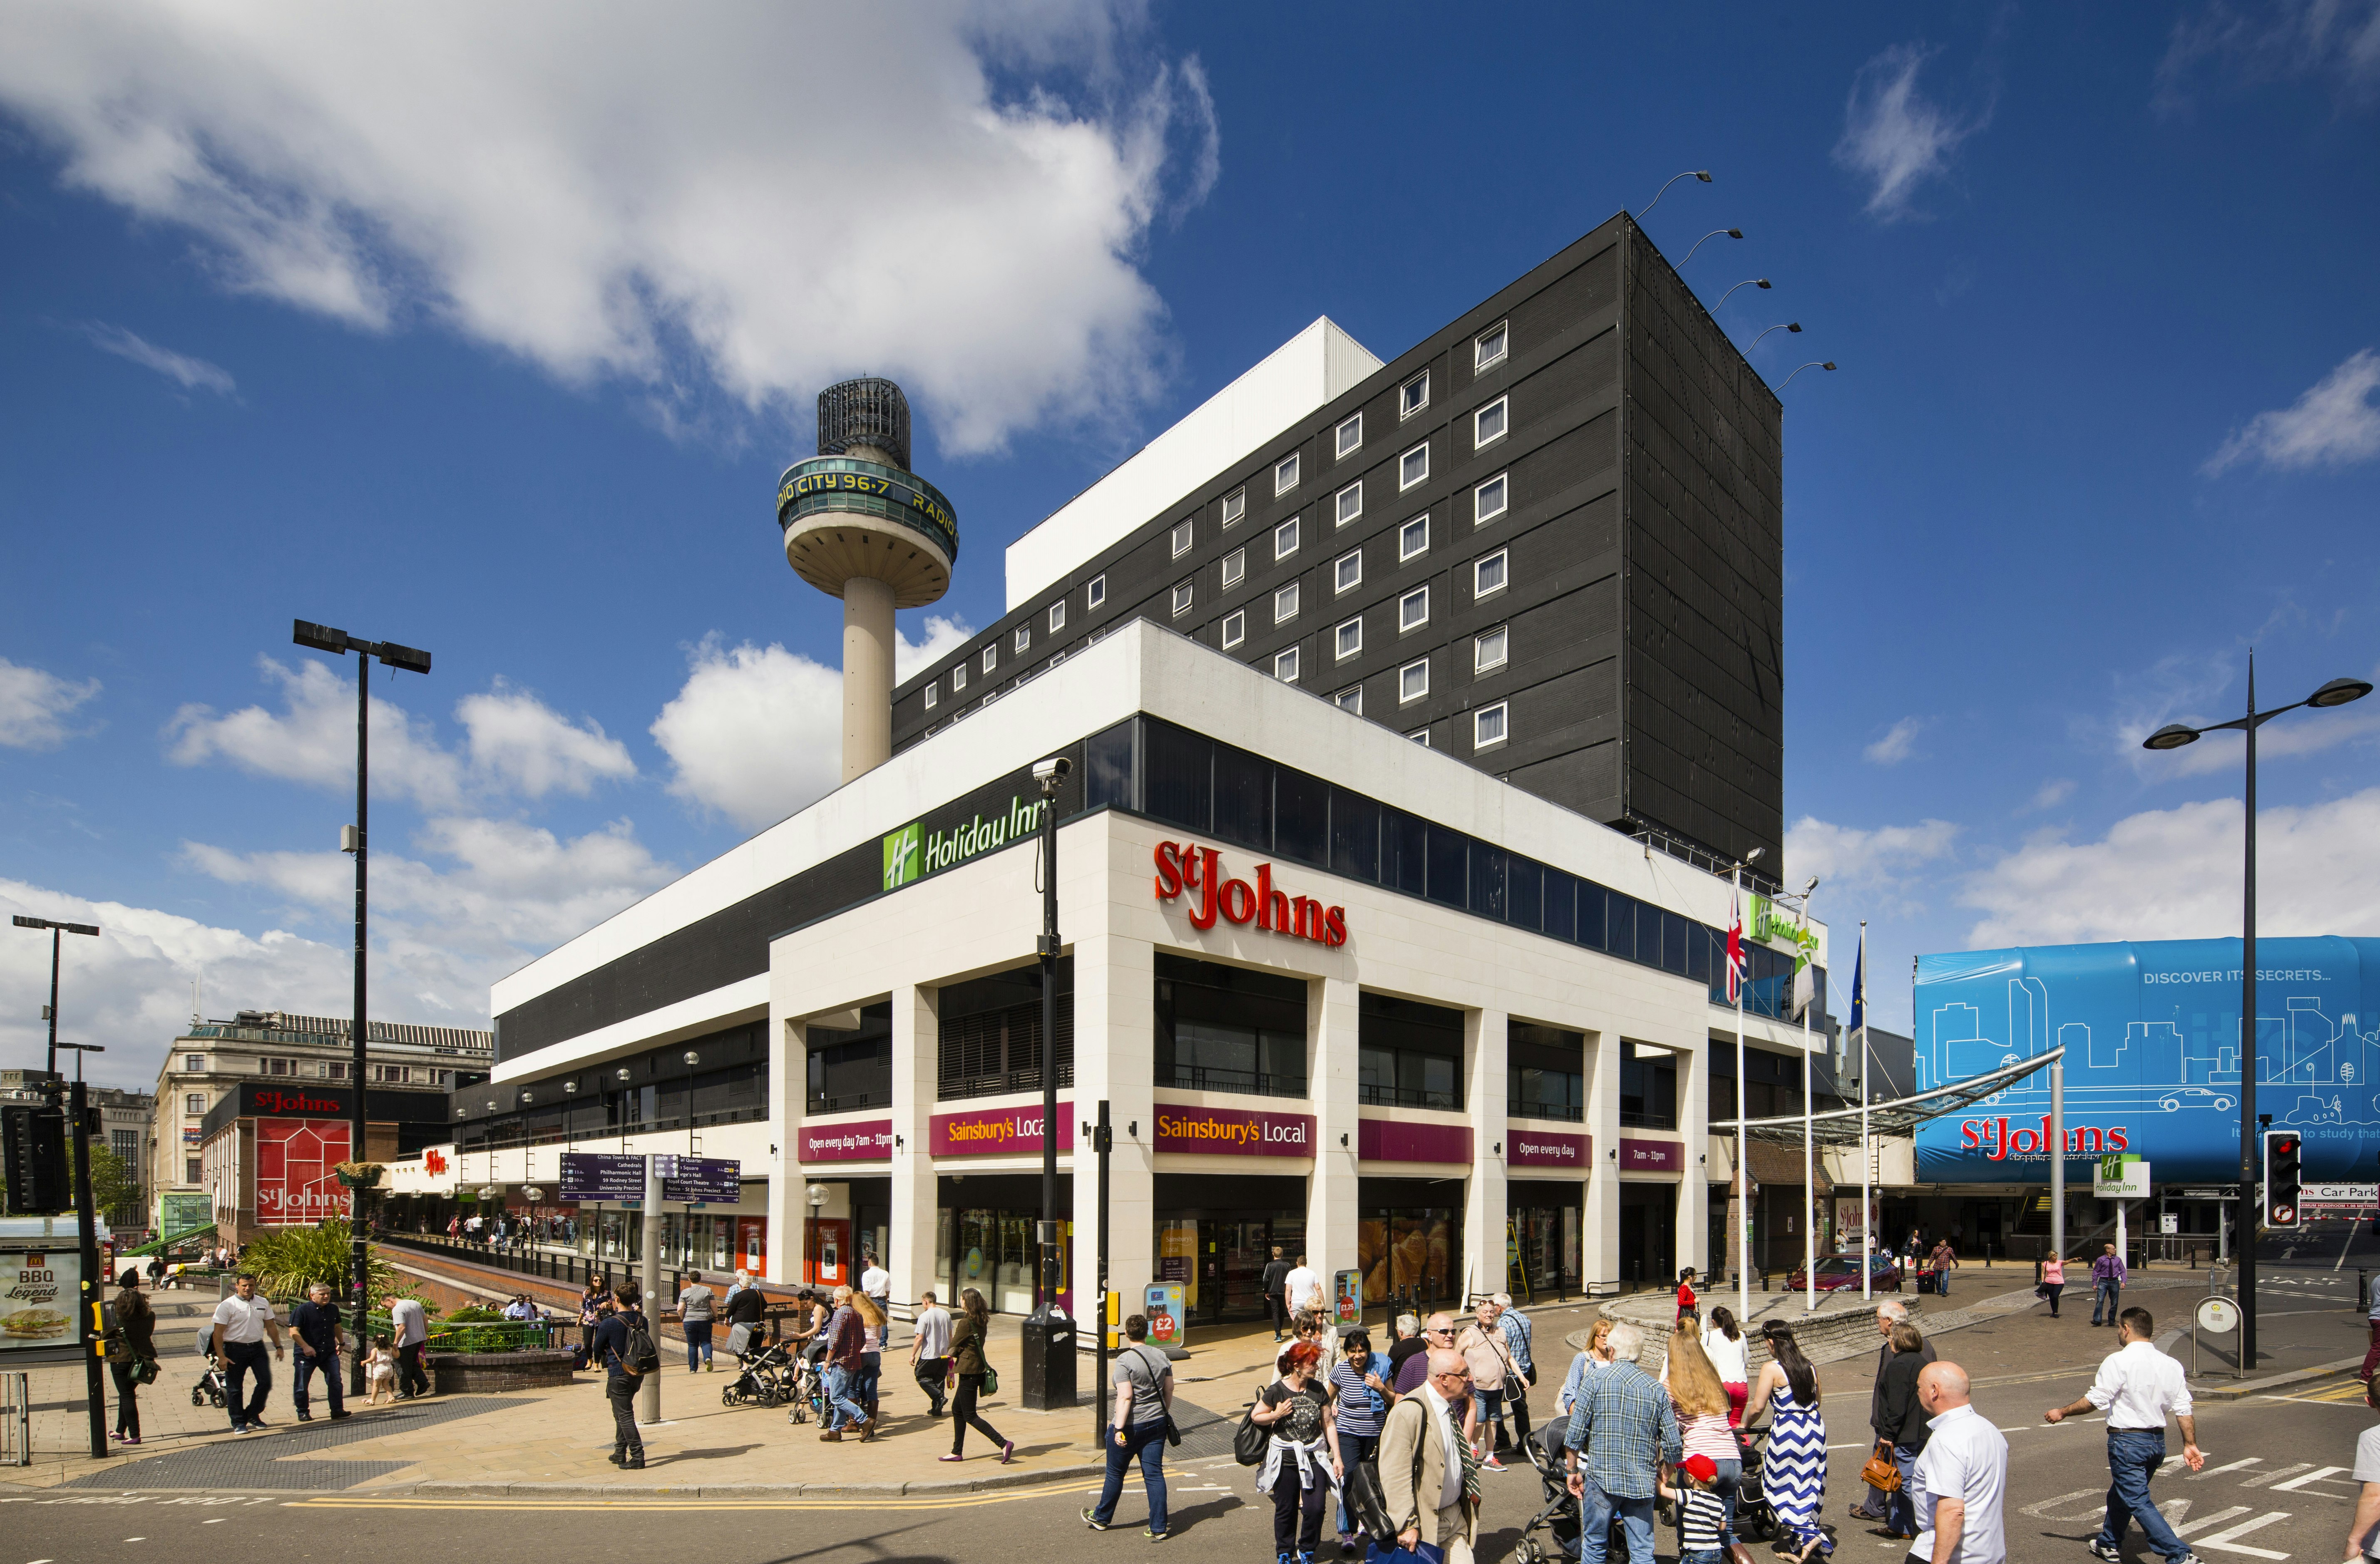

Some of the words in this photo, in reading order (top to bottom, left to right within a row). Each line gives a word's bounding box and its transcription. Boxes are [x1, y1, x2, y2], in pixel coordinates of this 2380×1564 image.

[776, 484, 794, 512] ADIO
[798, 474, 837, 493] CITY
[913, 493, 954, 536] RADIO
[924, 814, 1011, 873] Holiday
[2144, 971, 2223, 984] DISCOVER
[949, 1117, 1014, 1142] Sainsbury's
[1159, 1115, 1260, 1145] Sainsbury's
[1265, 1121, 1306, 1143] Local
[2303, 1129, 2315, 1138] to
[2319, 1128, 2354, 1140] study
[809, 1138, 824, 1151] Open
[825, 1138, 842, 1150] every
[843, 1135, 855, 1149] day
[855, 1135, 870, 1146] 7am
[875, 1133, 892, 1147] 11pm
[1519, 1142, 1539, 1156] Open
[1540, 1145, 1560, 1157] every
[1561, 1144, 1575, 1157] day
[1633, 1149, 1646, 1159] 7am
[1651, 1151, 1665, 1162] 11pm
[2010, 1153, 2049, 1162] Shopping
[2096, 1182, 2121, 1194] Holiday
[2122, 1183, 2137, 1191] Inn
[2321, 1187, 2345, 1197] Car
[2350, 1187, 2378, 1197] Park
[20, 1270, 55, 1283] BBQ
[4, 1286, 59, 1300] Legend
[1156, 1317, 1172, 1331] £2
